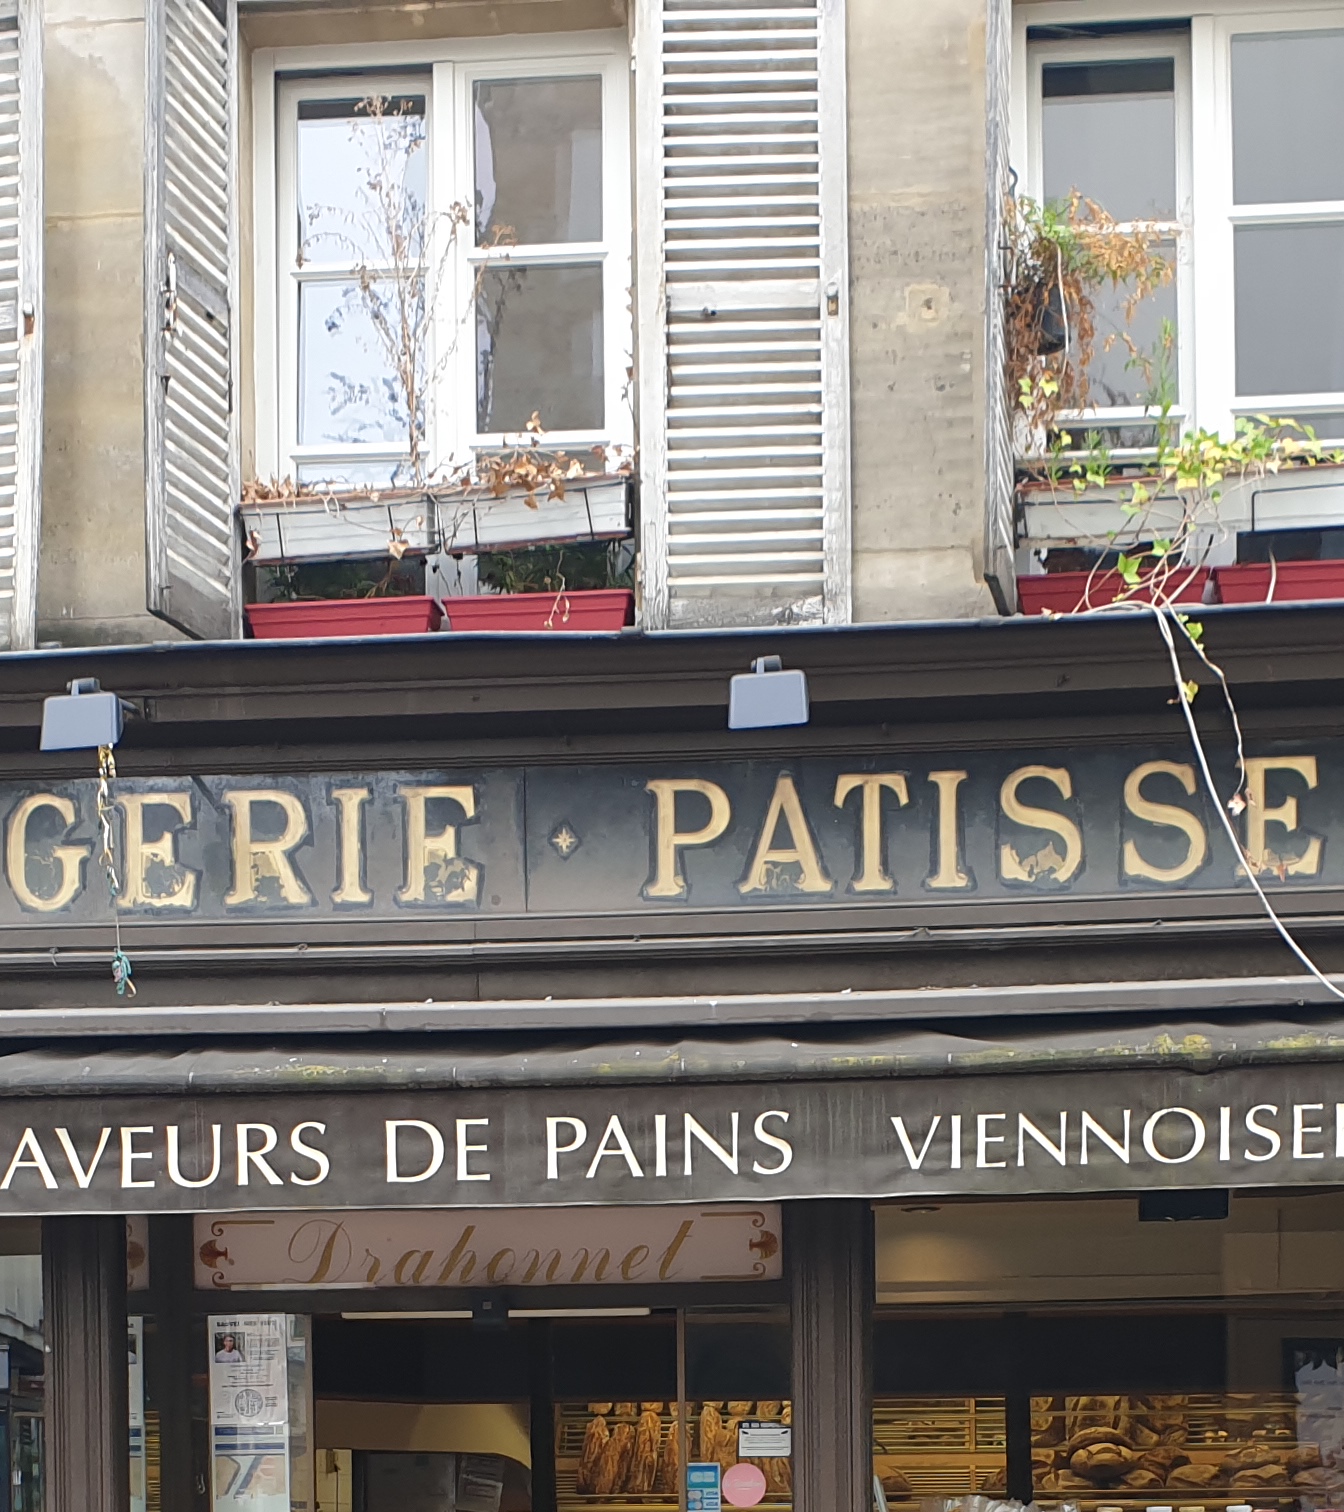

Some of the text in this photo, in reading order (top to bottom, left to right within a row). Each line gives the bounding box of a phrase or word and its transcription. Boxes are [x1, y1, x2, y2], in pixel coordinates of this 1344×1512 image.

[384, 1116, 491, 1183] DE
[545, 1109, 794, 1179] PAINS
[286, 1218, 694, 1287] Drahonnet
